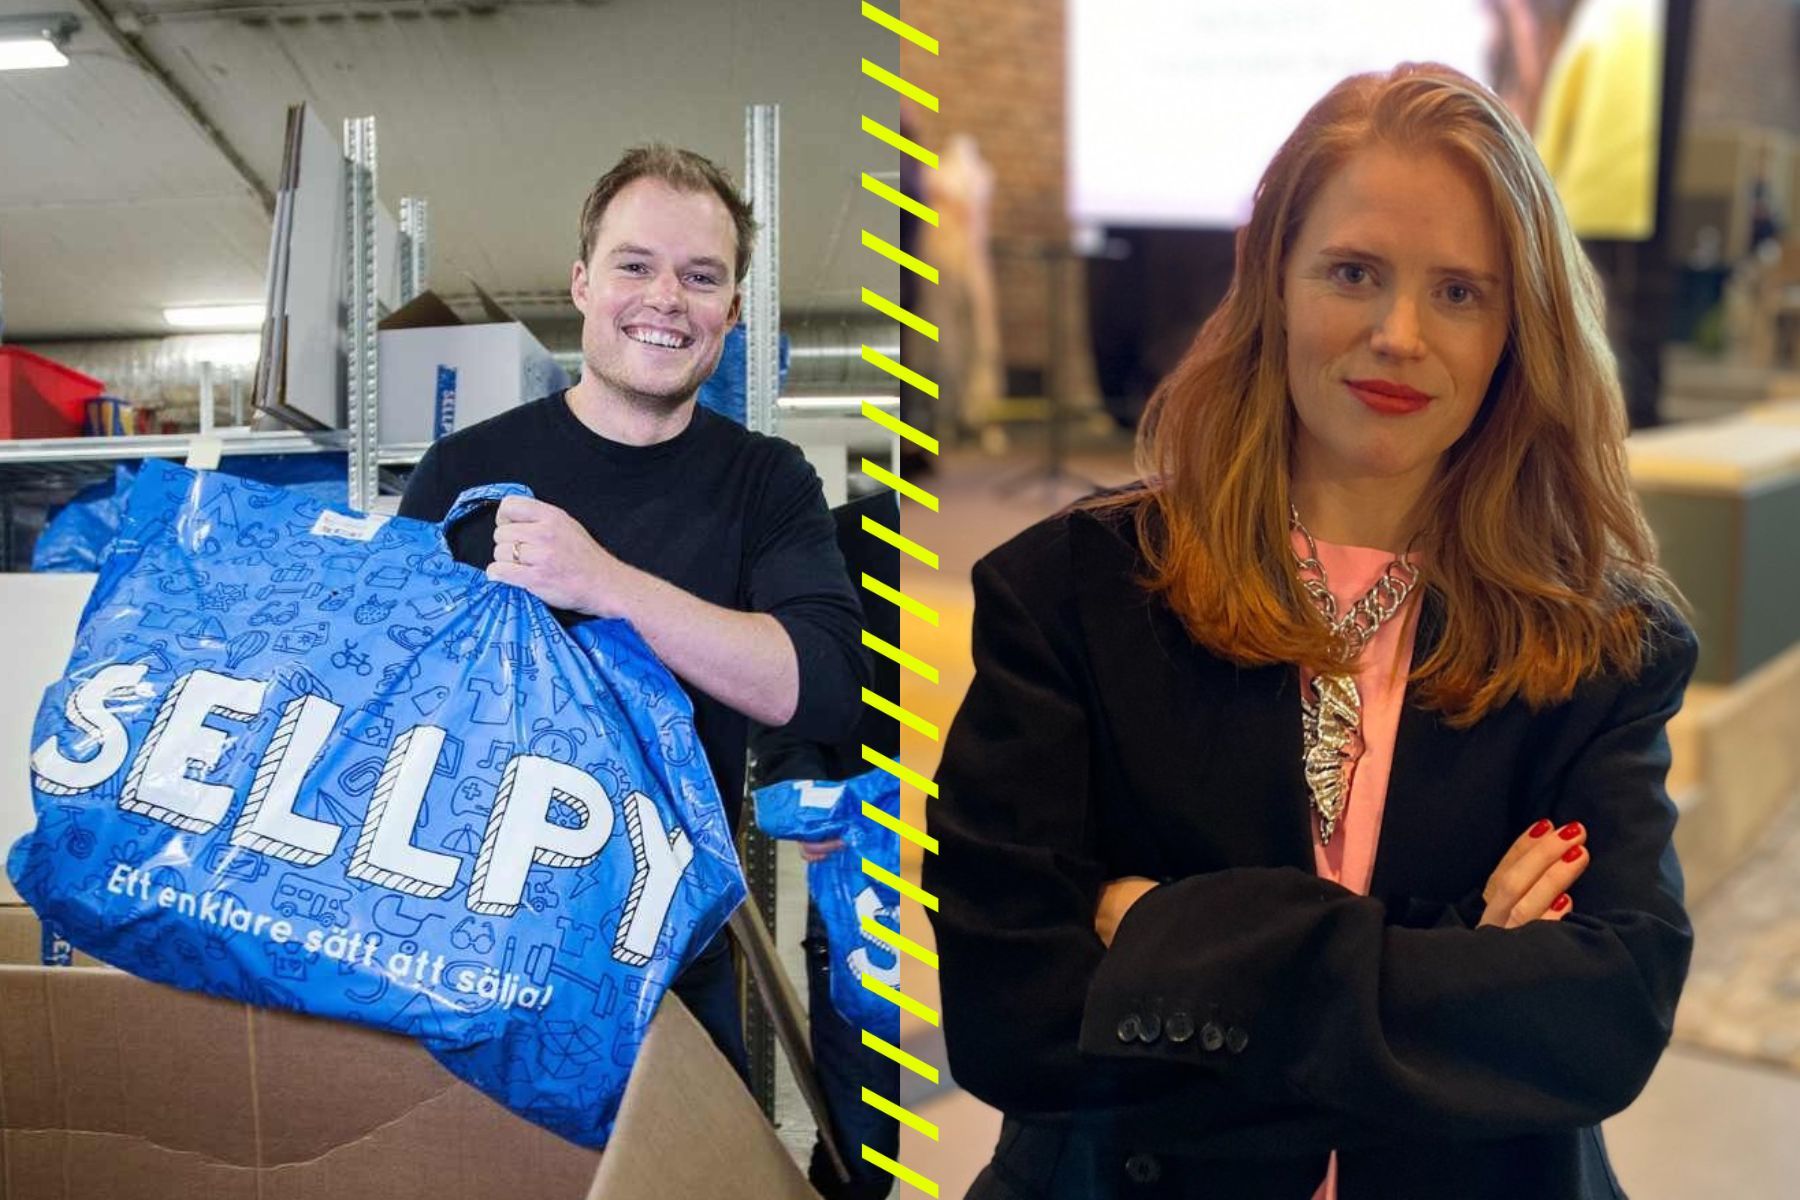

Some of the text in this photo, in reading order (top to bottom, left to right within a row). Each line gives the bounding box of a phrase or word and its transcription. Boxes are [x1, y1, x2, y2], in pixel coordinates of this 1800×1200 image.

[441, 389, 456, 437] SELLP
[30, 663, 694, 967] SELLPY
[107, 863, 554, 1011] Ett enklare sätt att sälja!
